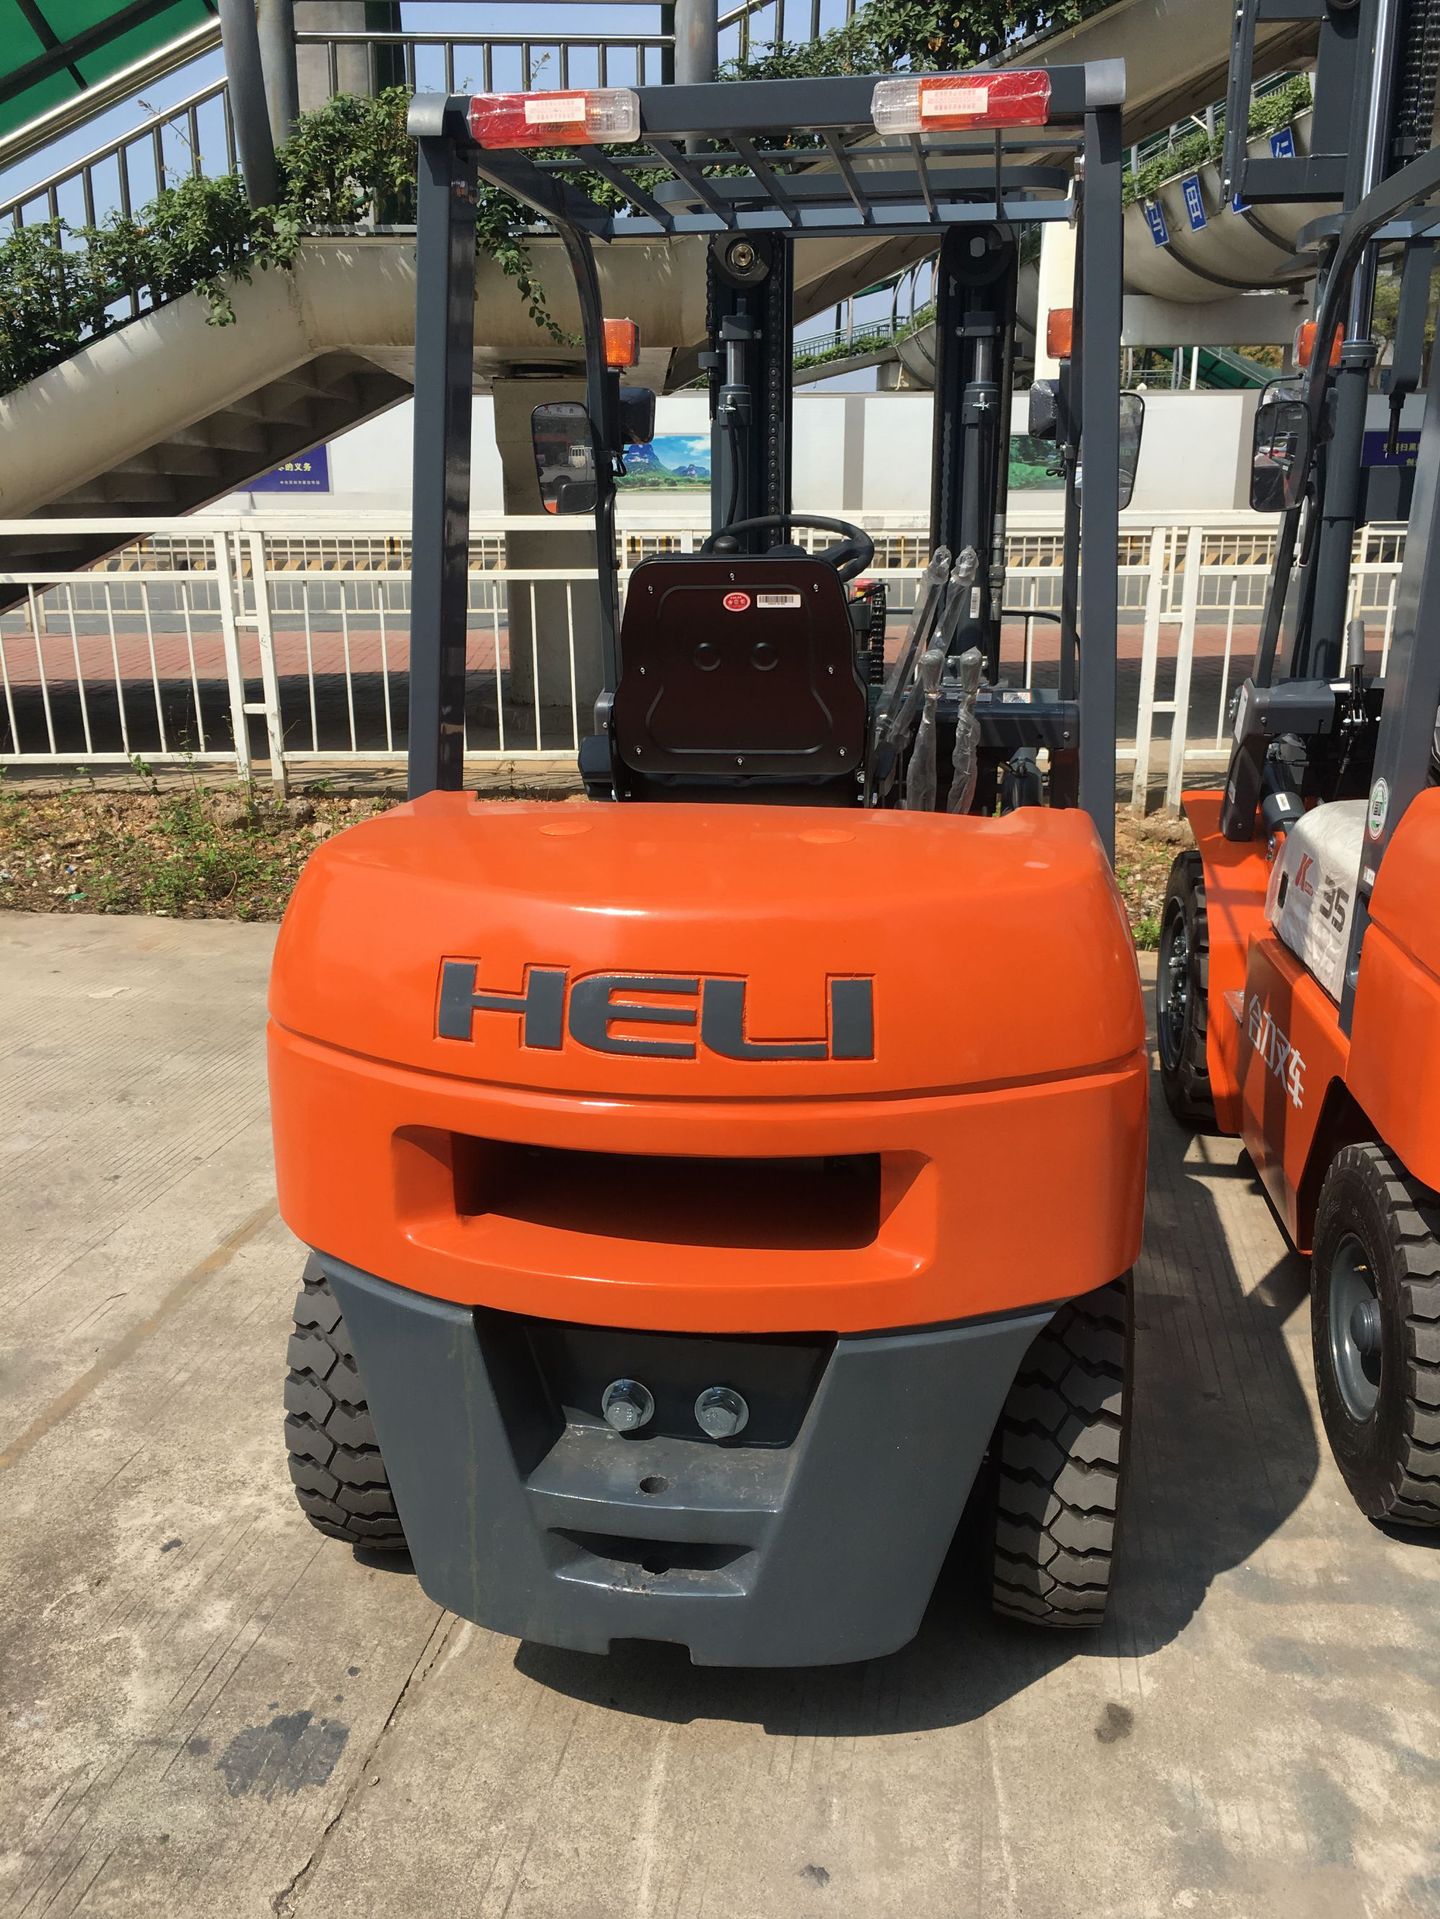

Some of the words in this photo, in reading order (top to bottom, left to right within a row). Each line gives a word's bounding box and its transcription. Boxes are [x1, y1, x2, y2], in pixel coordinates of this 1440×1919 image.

[1319, 875, 1350, 933] 35
[436, 956, 876, 1062] HELI
[1248, 993, 1307, 1109] 合力叉车
